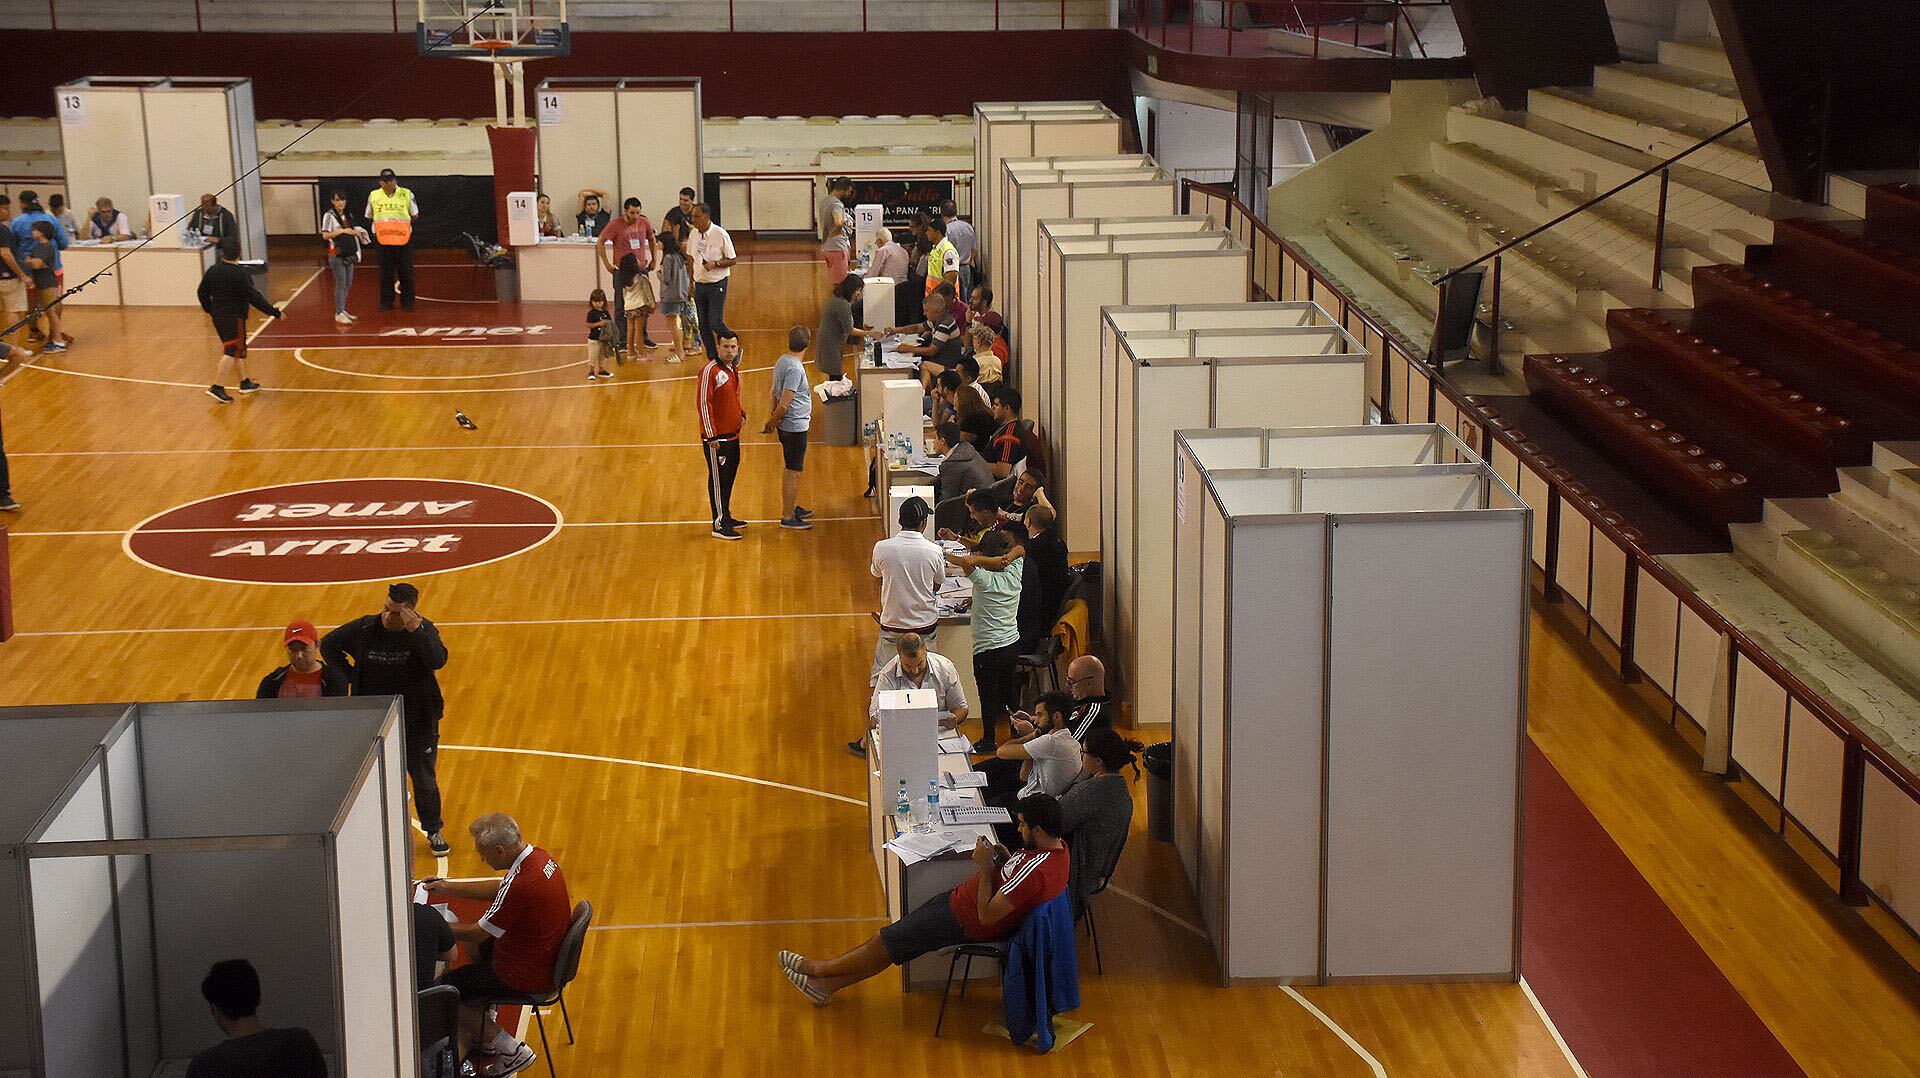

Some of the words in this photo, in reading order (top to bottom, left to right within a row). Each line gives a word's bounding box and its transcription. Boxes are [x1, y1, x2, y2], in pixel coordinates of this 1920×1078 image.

[64, 96, 80, 109] 13
[543, 97, 558, 109] 14
[157, 201, 168, 211] 13
[514, 199, 526, 209] 14
[861, 212, 873, 222] 15
[379, 325, 553, 337] Arnet
[235, 500, 475, 522] Arnet
[209, 534, 463, 558] Arnet
